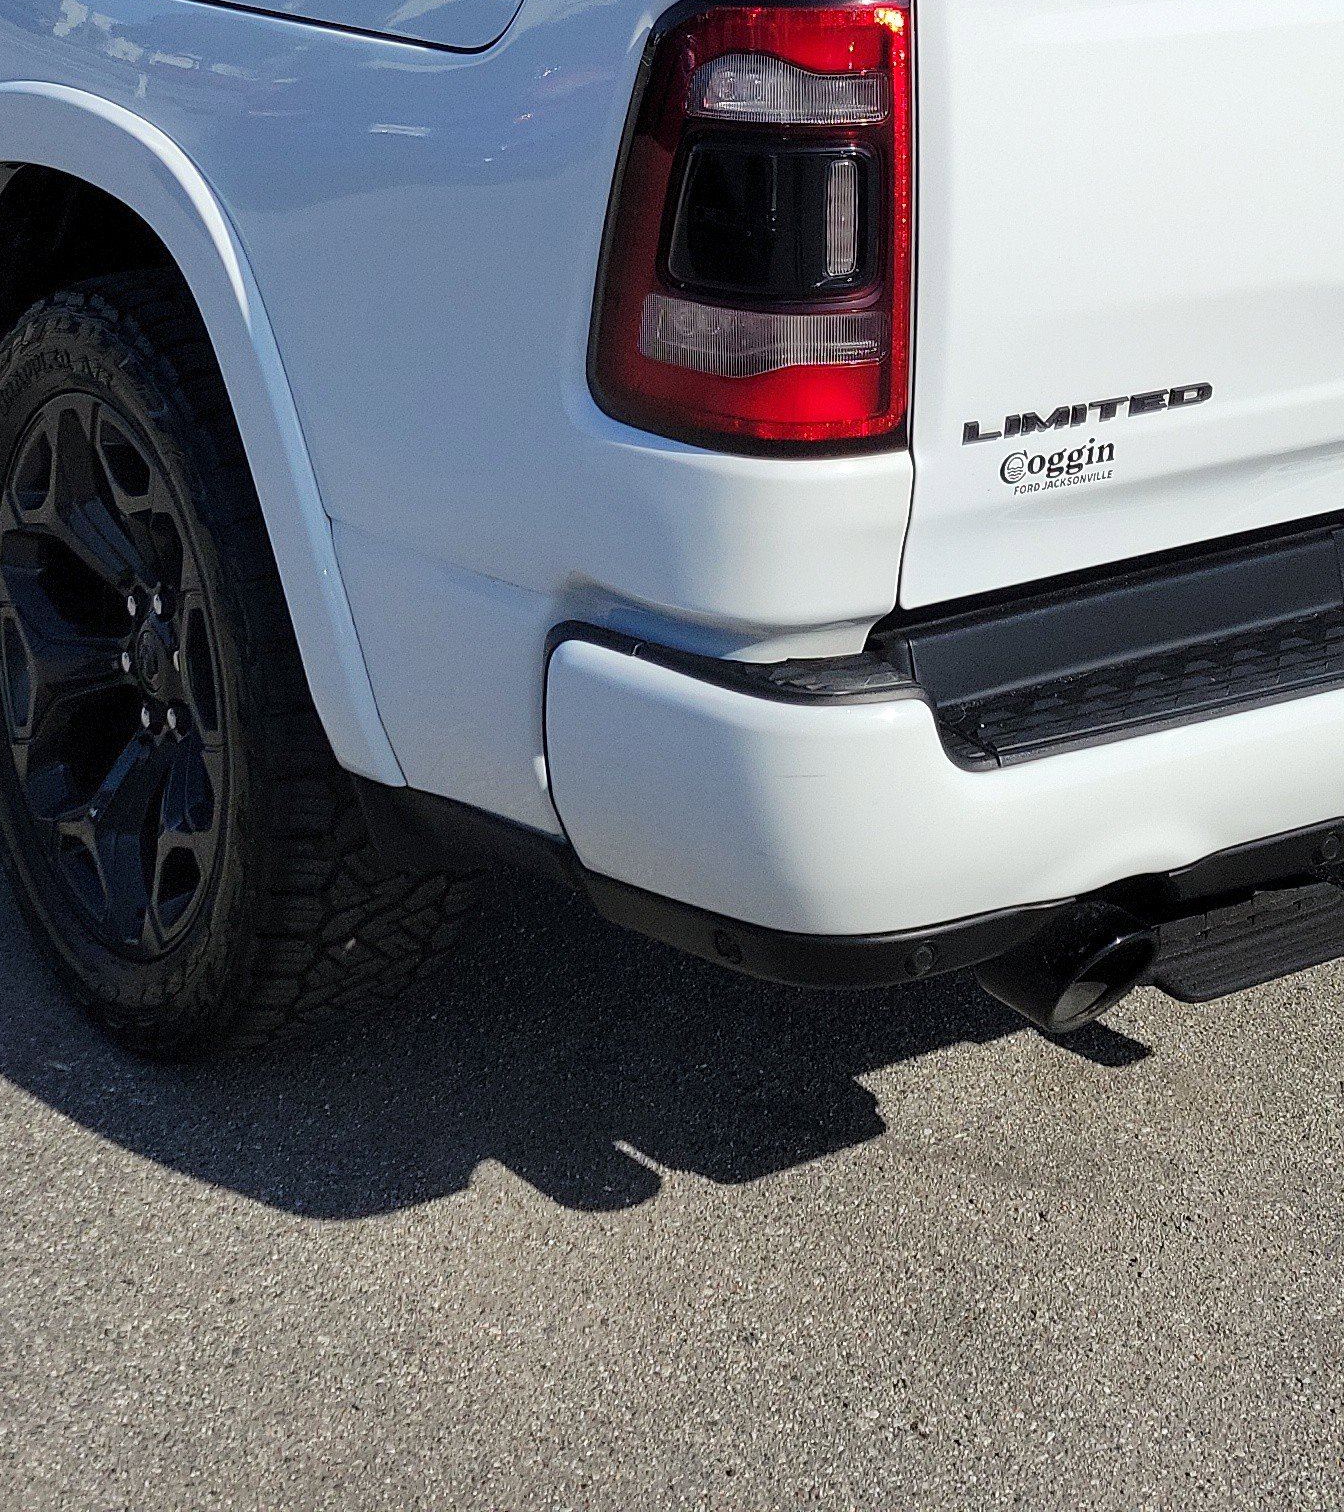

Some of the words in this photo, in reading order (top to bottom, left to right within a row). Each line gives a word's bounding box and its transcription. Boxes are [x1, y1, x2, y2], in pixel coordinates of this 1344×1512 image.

[962, 381, 1214, 446] LIMITED
[999, 437, 1115, 485] Coggin
[1013, 481, 1040, 496] FORD
[1042, 469, 1114, 491] JACKSONVILLE
